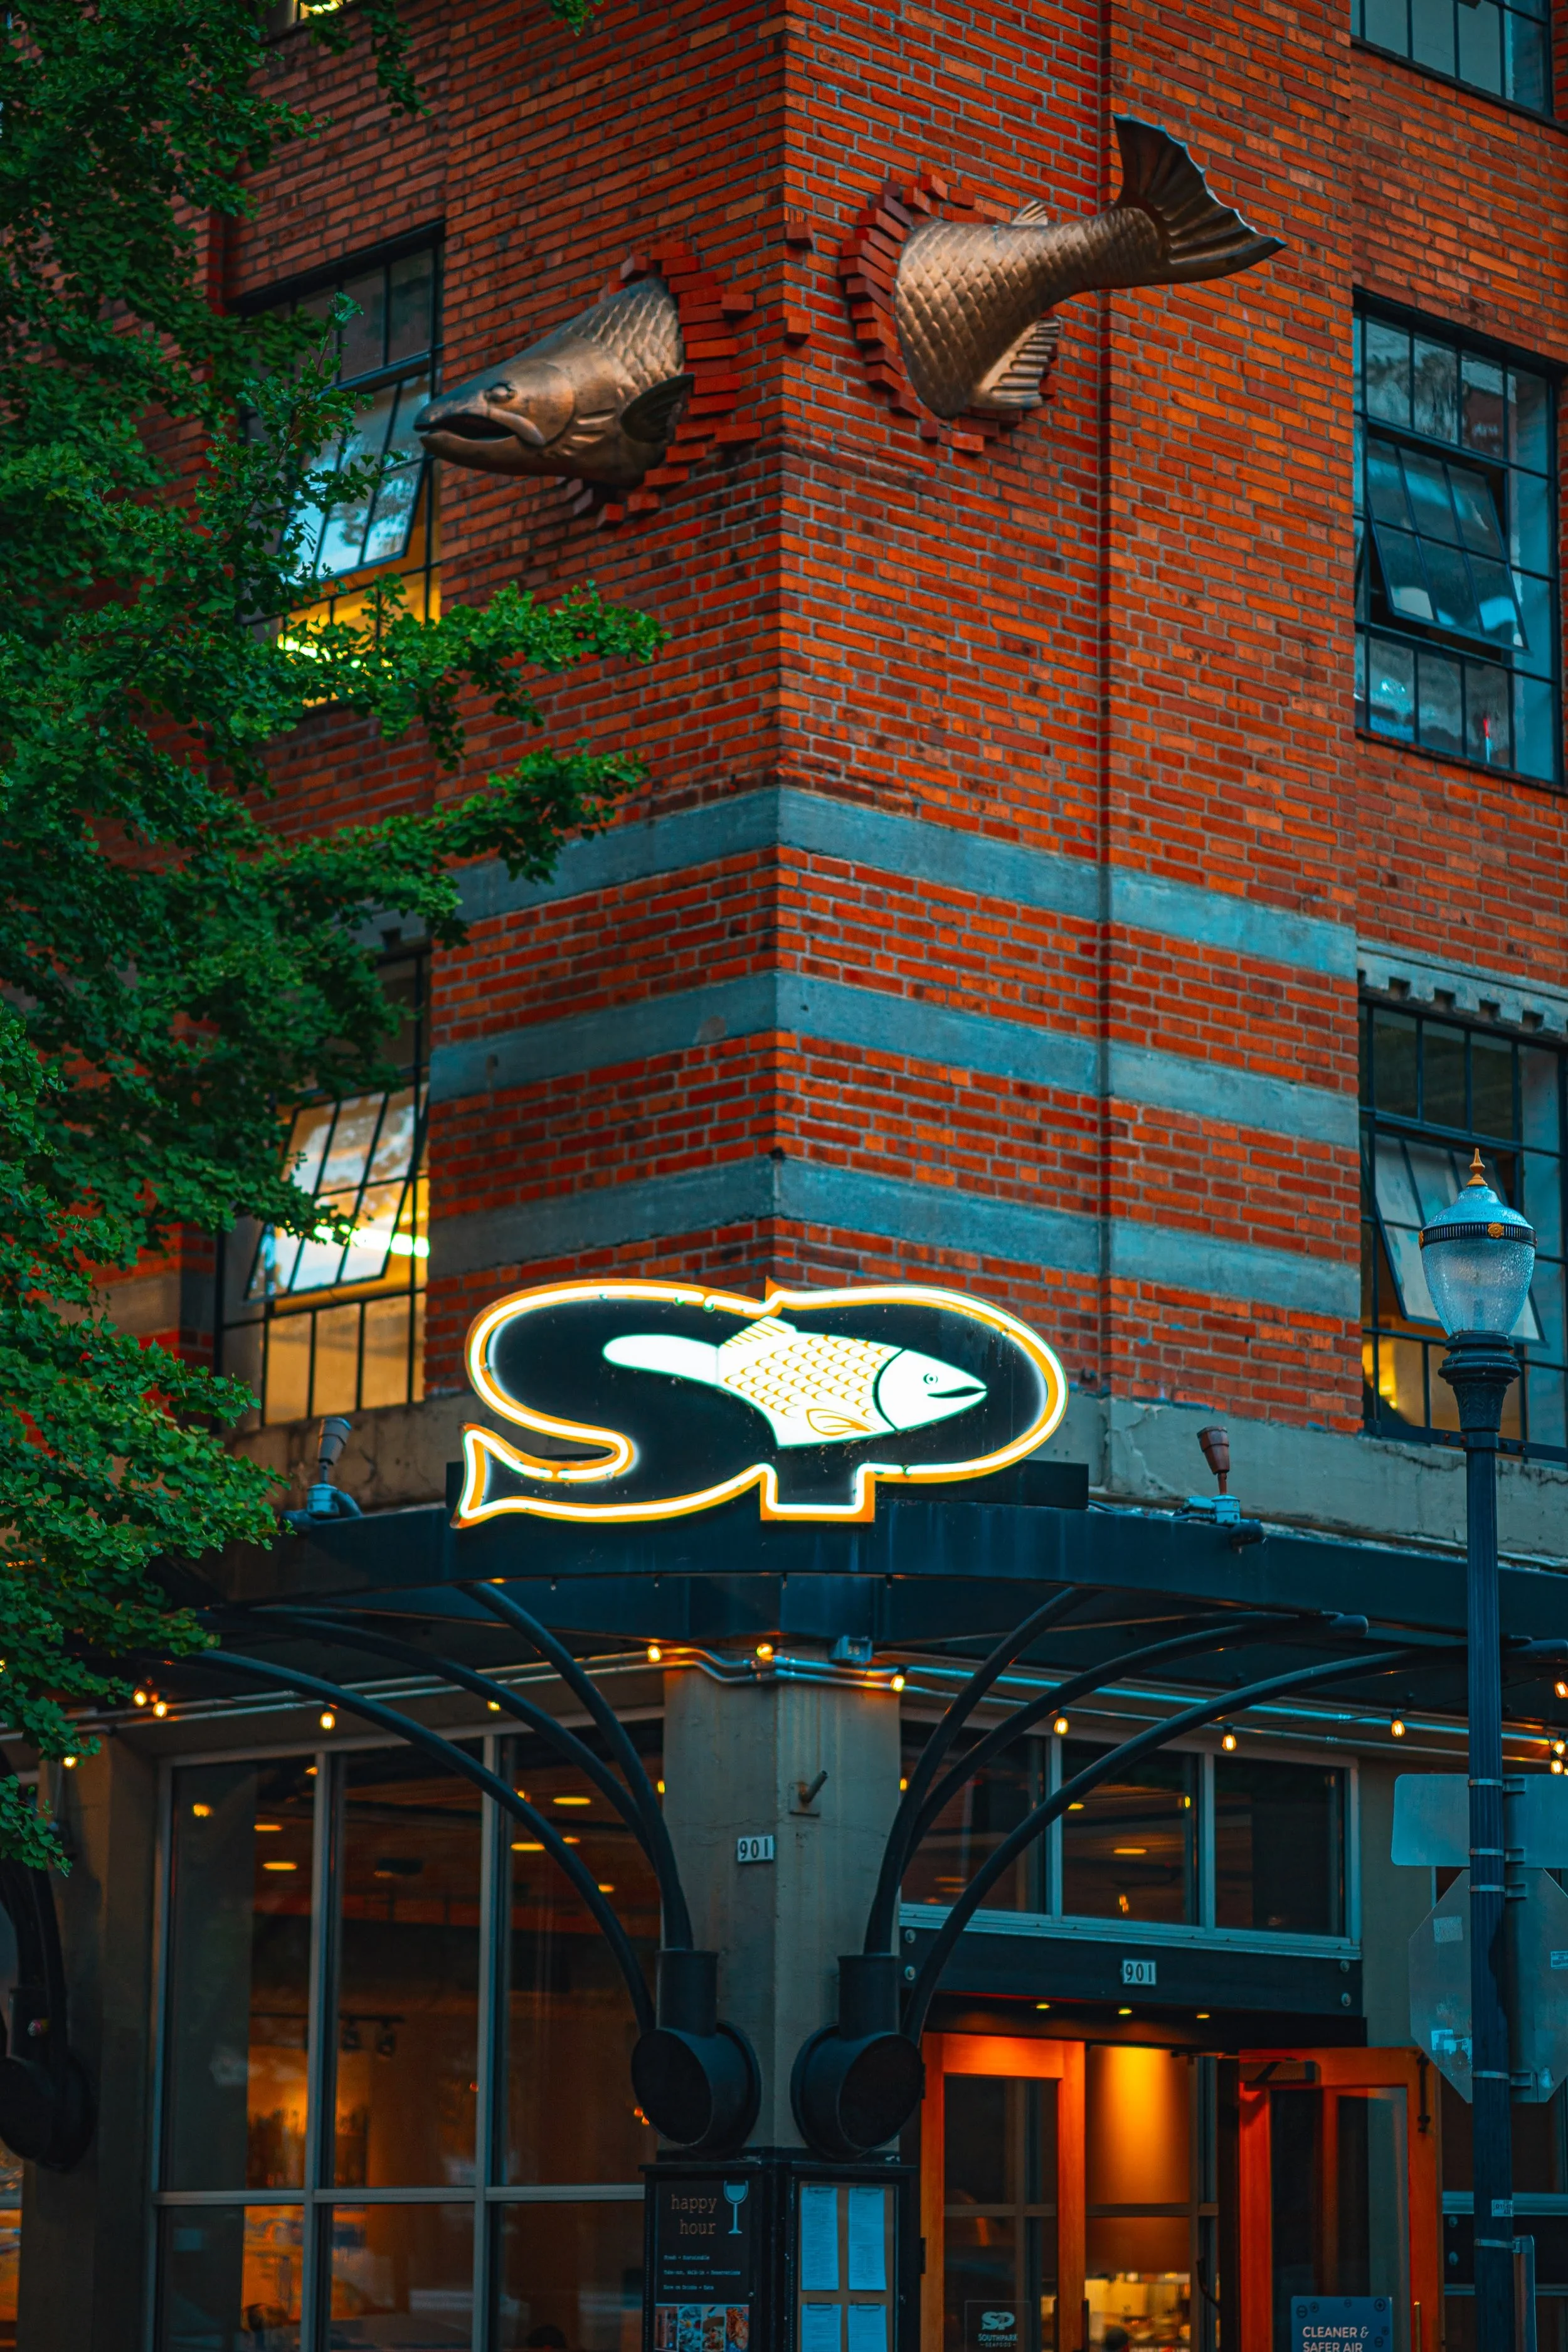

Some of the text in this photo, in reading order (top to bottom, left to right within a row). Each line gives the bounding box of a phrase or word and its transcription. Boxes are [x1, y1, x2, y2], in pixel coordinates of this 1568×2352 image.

[739, 1838, 769, 1860] 901
[1125, 1963, 1152, 1983] 901
[670, 2193, 718, 2213] happy
[679, 2219, 717, 2235] hour
[981, 2311, 1015, 2331] SP
[1302, 2326, 1370, 2338] CLEANER &
[1303, 2341, 1364, 2352] SAFER AIR
